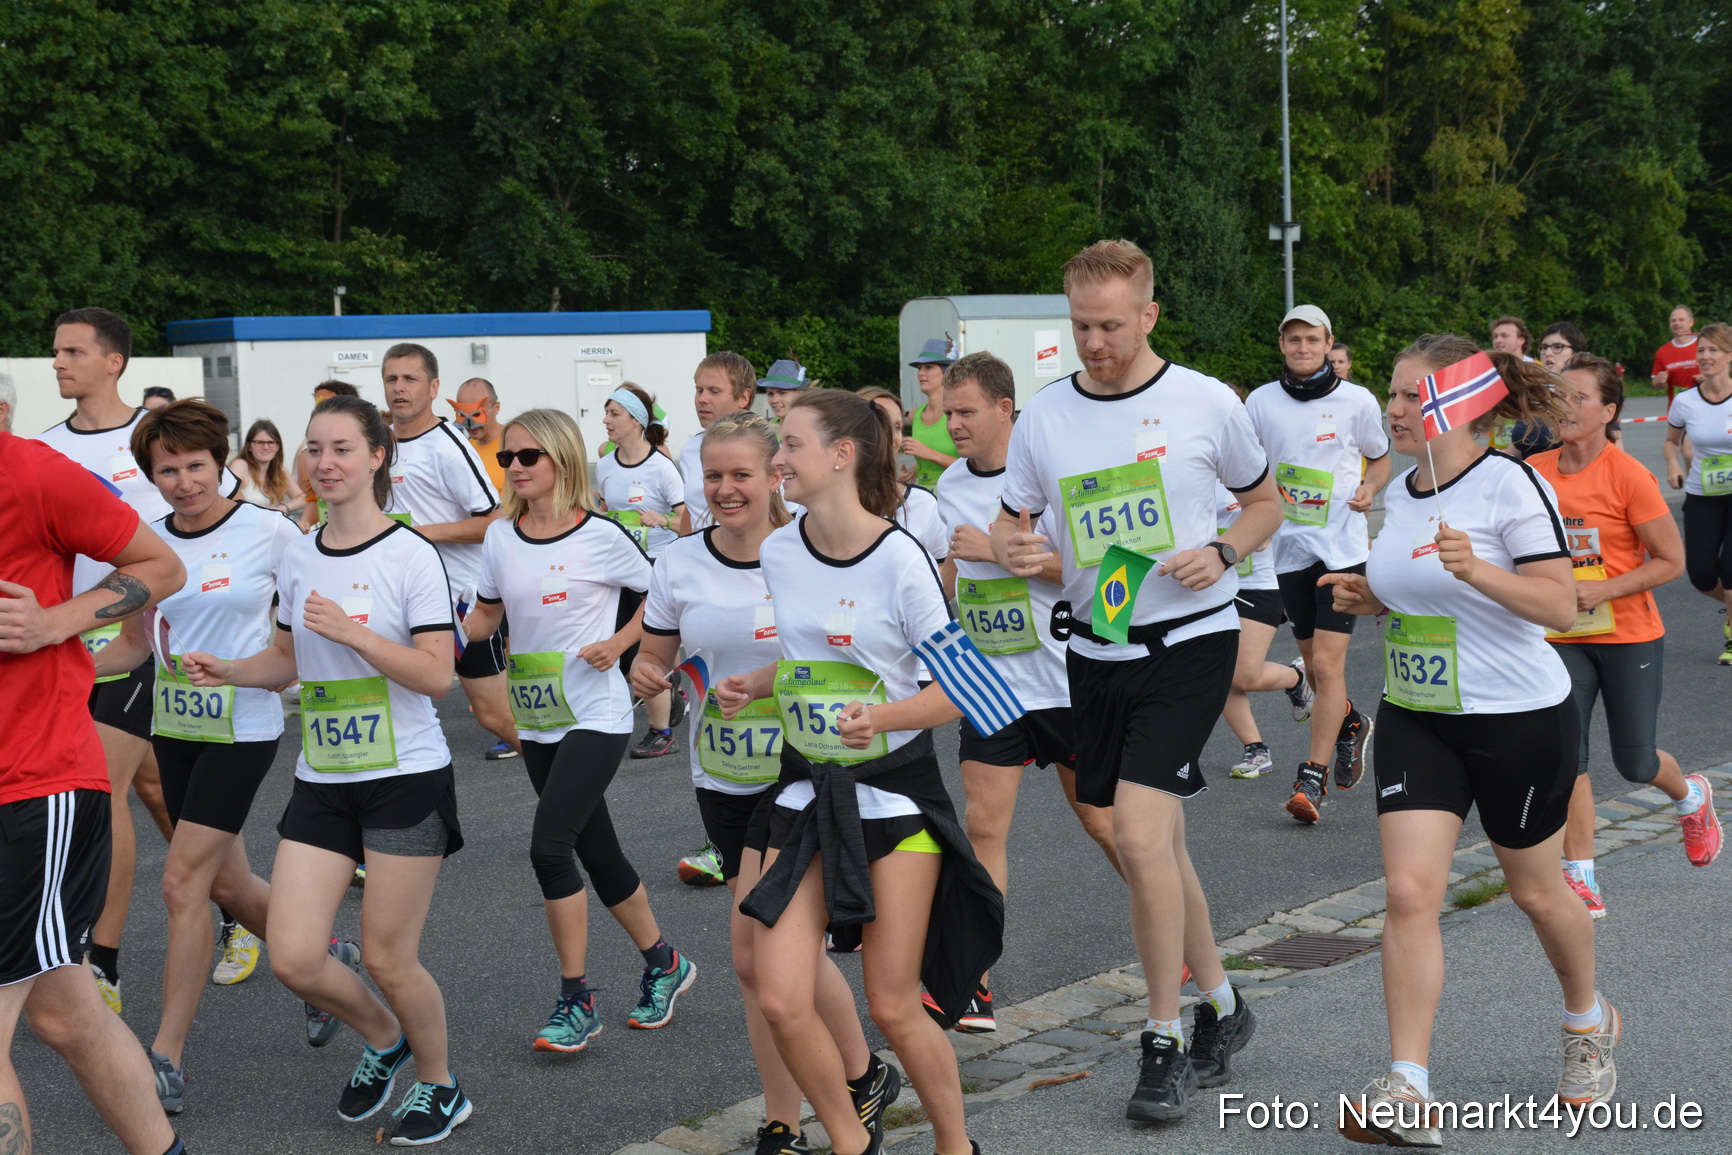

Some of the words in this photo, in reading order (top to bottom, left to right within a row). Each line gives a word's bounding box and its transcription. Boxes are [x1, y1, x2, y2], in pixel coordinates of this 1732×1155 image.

[1080, 498, 1158, 539] 1516
[966, 608, 1024, 634] 1549
[788, 678, 826, 686] firmenlauf
[1390, 649, 1448, 686] 1532
[161, 687, 222, 719] 1530
[511, 684, 558, 709] 1521
[310, 714, 380, 746] 1547
[705, 723, 780, 757] 1517
[342, 751, 368, 760] Spangler
